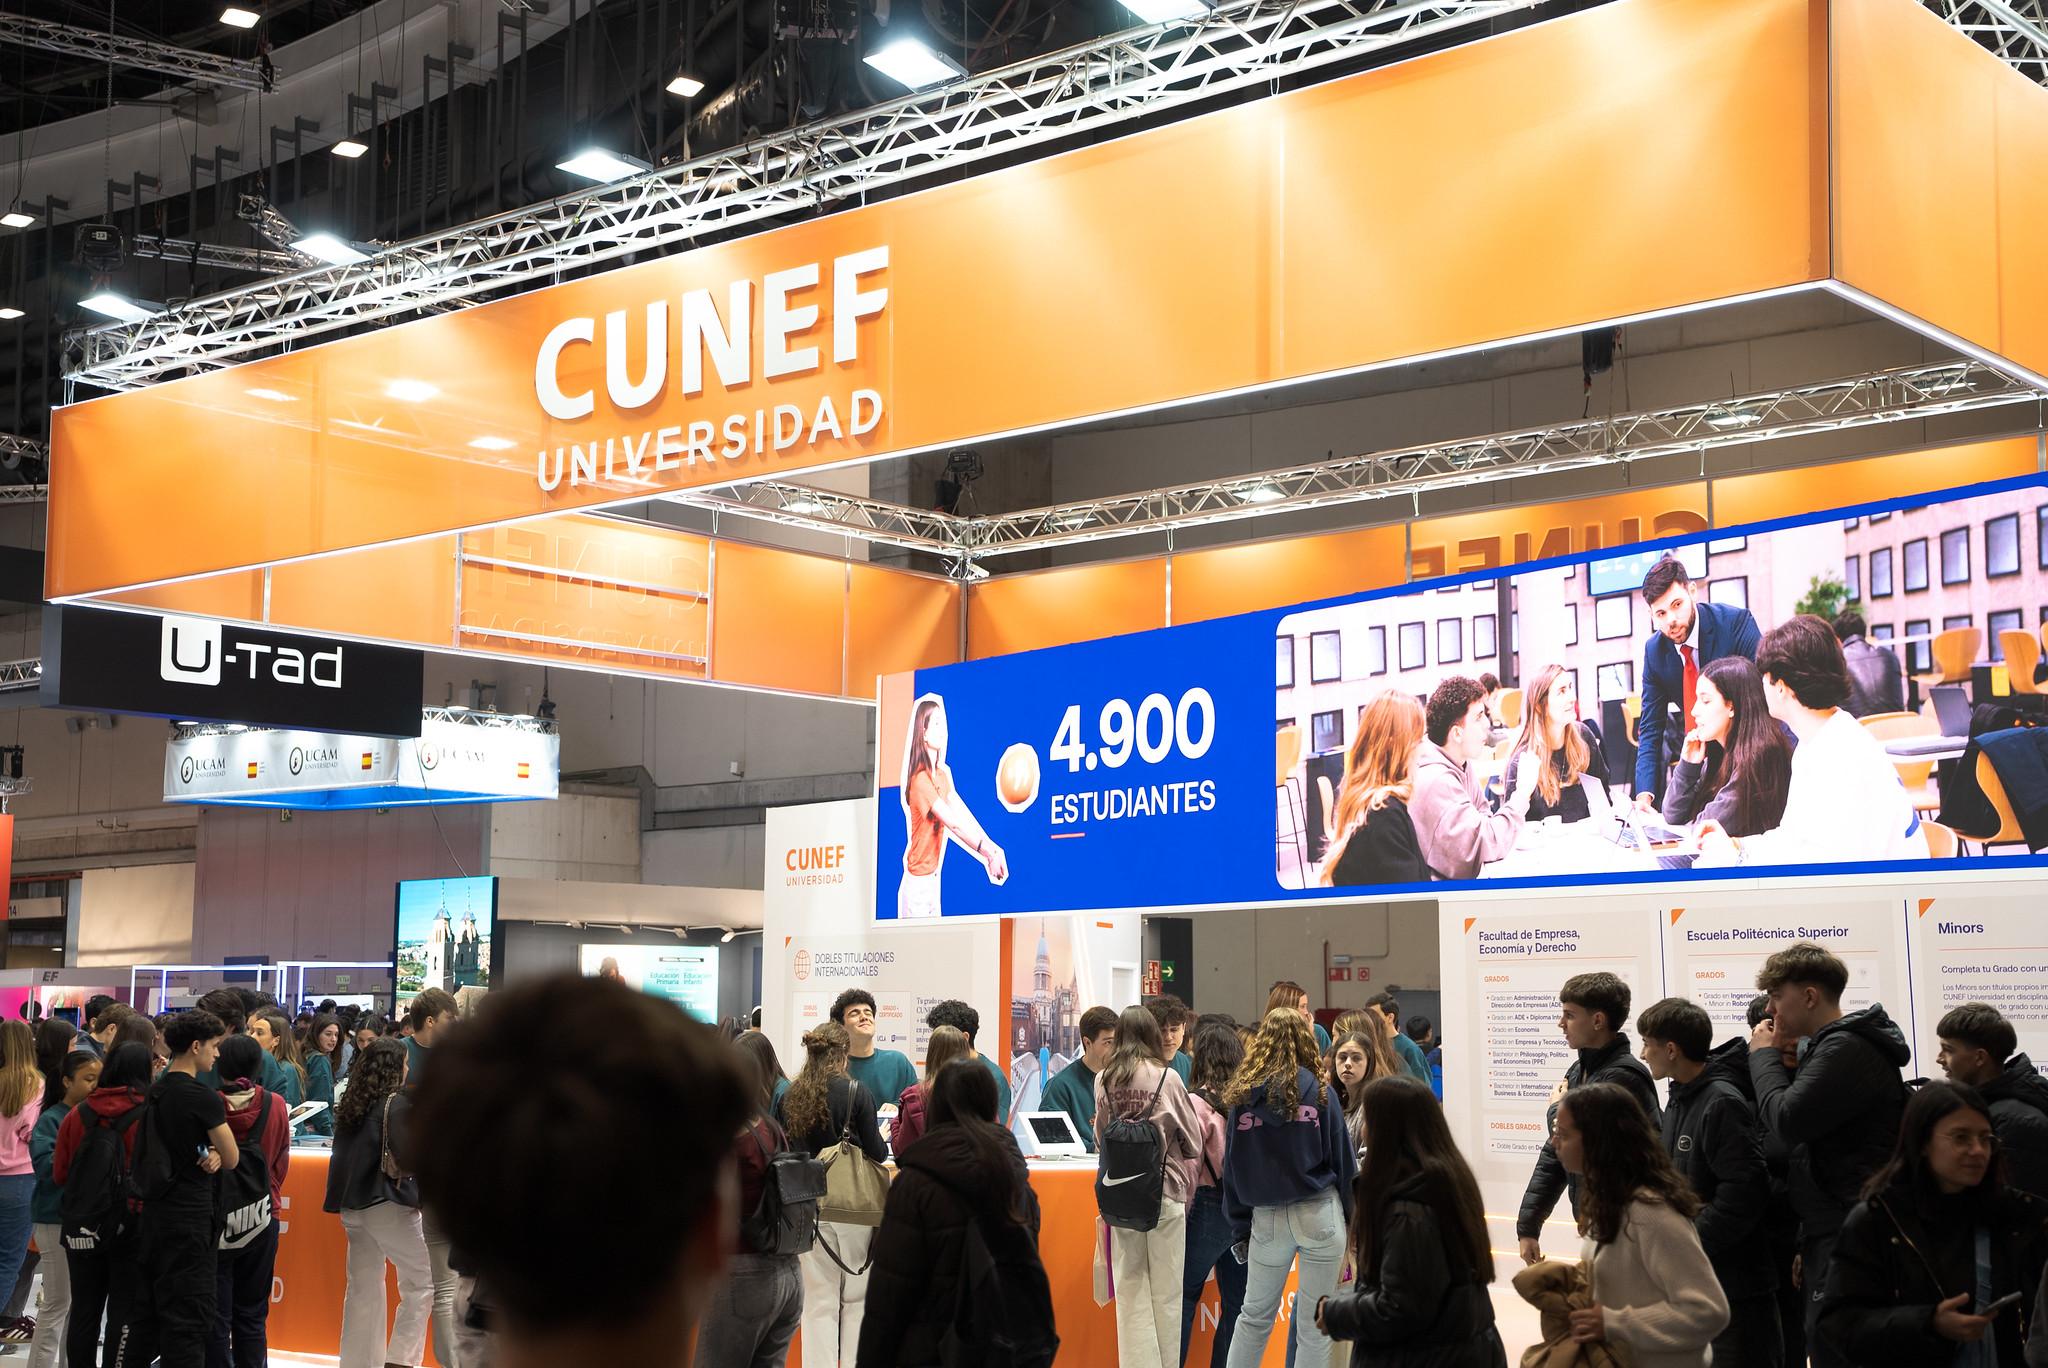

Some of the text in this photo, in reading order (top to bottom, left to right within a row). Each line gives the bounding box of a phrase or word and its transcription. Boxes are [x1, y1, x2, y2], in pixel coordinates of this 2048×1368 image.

[535, 245, 889, 419] CUNEF
[537, 388, 883, 491] UNIVERSIDAD
[1050, 687, 1215, 772] 4.900
[305, 748, 338, 762] UCAM
[195, 757, 226, 770] UCAM
[1051, 780, 1215, 824] ESTUDIANTES
[786, 845, 845, 871] CUNEF
[786, 874, 844, 887] UNIVERSIDAD
[1687, 925, 1849, 942] Escuela Politécnica Superior
[1938, 922, 1984, 934] Minors
[1479, 929, 1580, 941] Facultad de Empresa,
[1479, 942, 1577, 955] Economía y Derecho
[815, 951, 895, 964] DOBLES TITULACIONES
[815, 965, 879, 977] INTERNACIONALES
[1941, 965, 1981, 975] Completa
[1982, 965, 1991, 973] tu
[1993, 964, 2018, 973] Grado
[42, 971, 59, 982] EF
[2014, 984, 2039, 992] propios
[2008, 1003, 2028, 1011] grado
[1116, 1101, 1145, 1112] WITH
[1490, 1122, 1541, 1131] DOBLES GRADOS
[1496, 1142, 1511, 1150] Doble
[226, 1194, 272, 1238] NIKE
